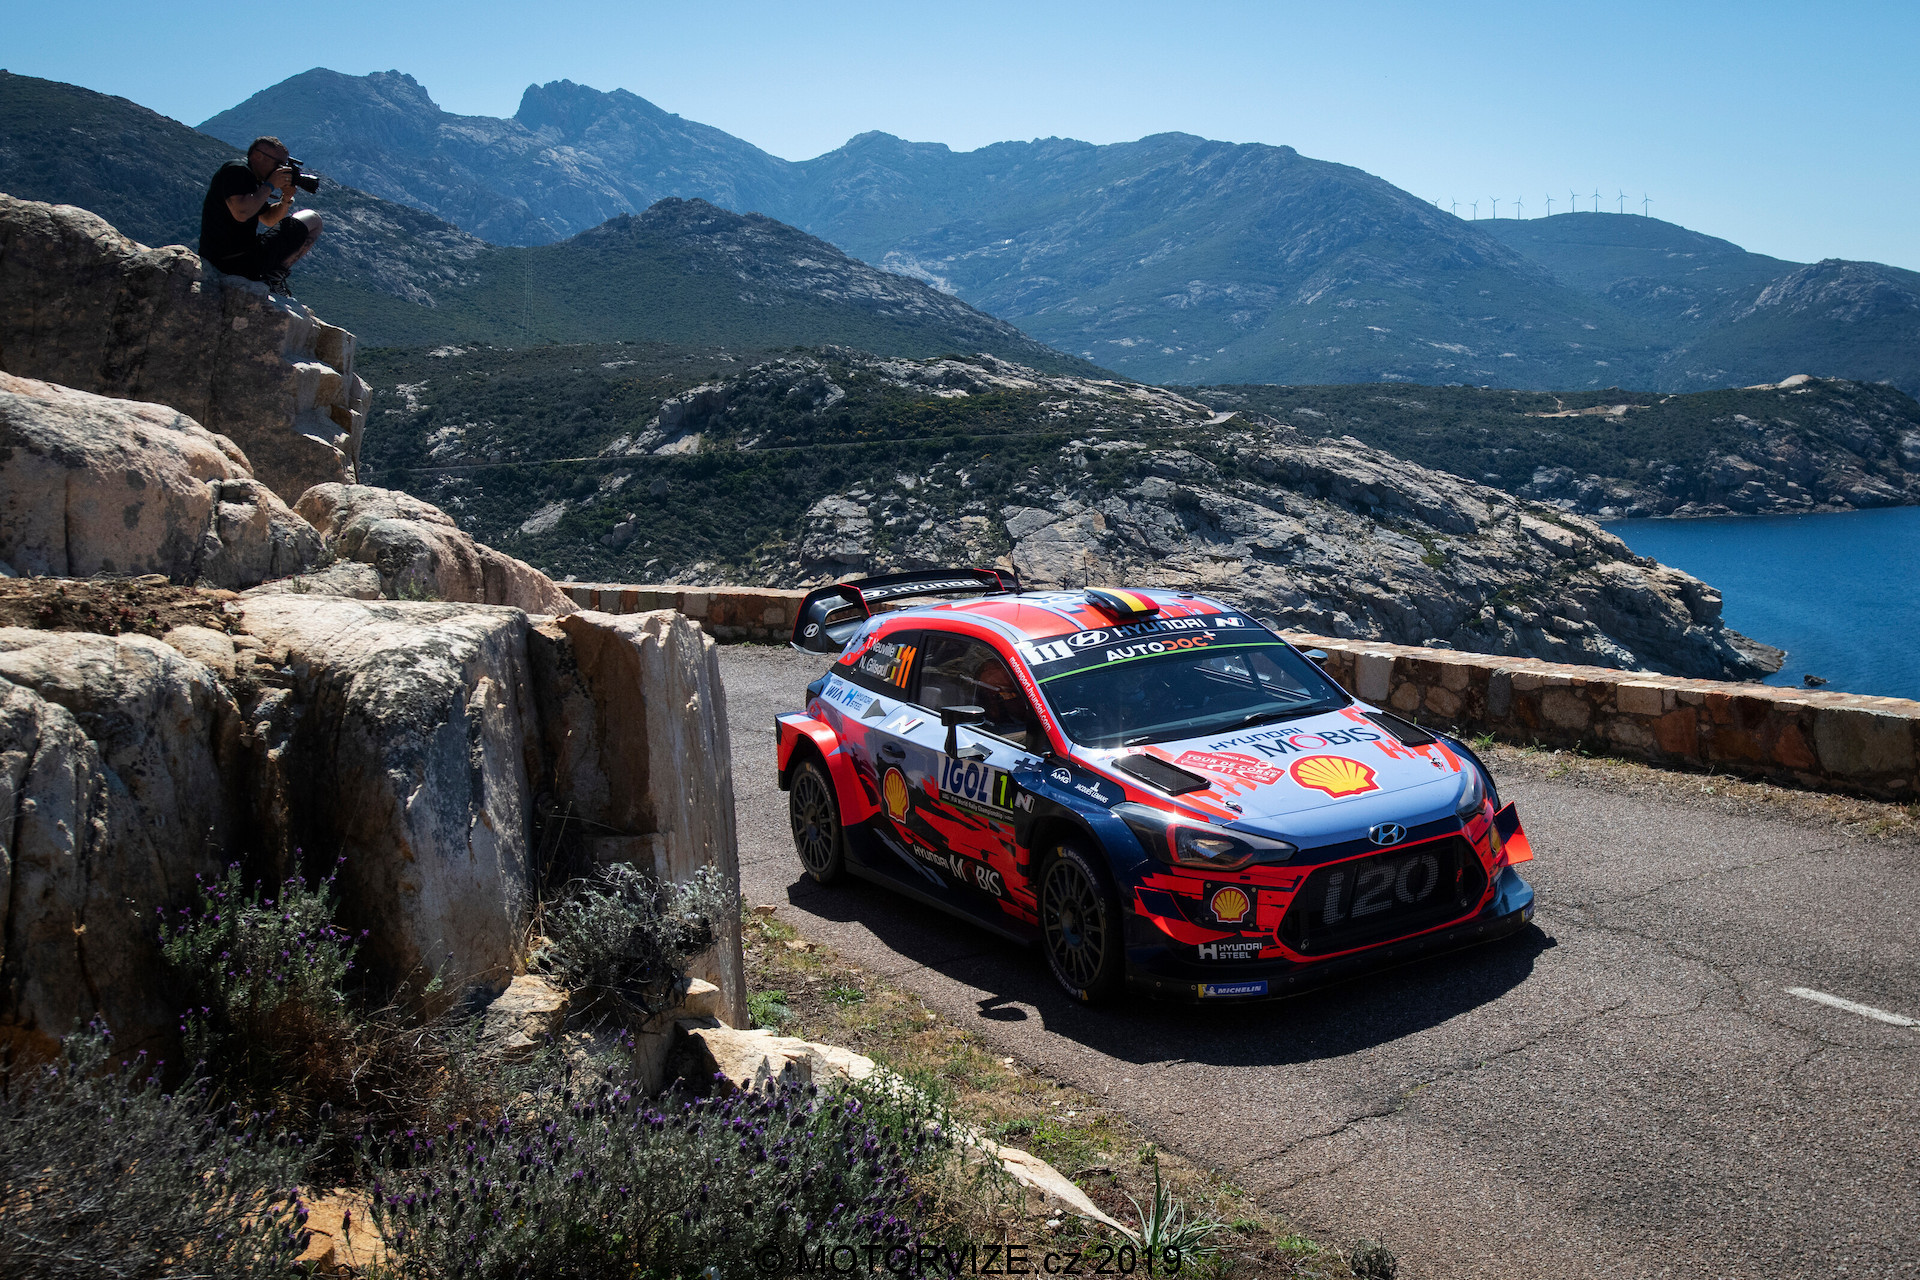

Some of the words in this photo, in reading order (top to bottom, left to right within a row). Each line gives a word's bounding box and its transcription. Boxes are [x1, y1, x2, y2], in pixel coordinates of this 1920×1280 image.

[892, 580, 984, 593] HYUNDAI
[1112, 618, 1207, 638] HYUNDAI
[870, 638, 896, 657] Neuville
[1035, 644, 1063, 661] 11
[866, 658, 888, 677] Gilsoul
[896, 645, 917, 689] 11
[1009, 656, 1052, 733] motorsport.hyundai.com
[1208, 728, 1304, 750] HYUNDAI
[1251, 727, 1381, 757] MOBIS
[1186, 754, 1218, 764] TOUR
[1239, 764, 1278, 777] CORSE
[942, 756, 988, 803] IGOL
[913, 844, 949, 869] HYUNDAI
[949, 854, 1001, 896] MOBIS
[1219, 942, 1263, 952] HYUNDAI
[1217, 985, 1262, 994] MICHELIN
